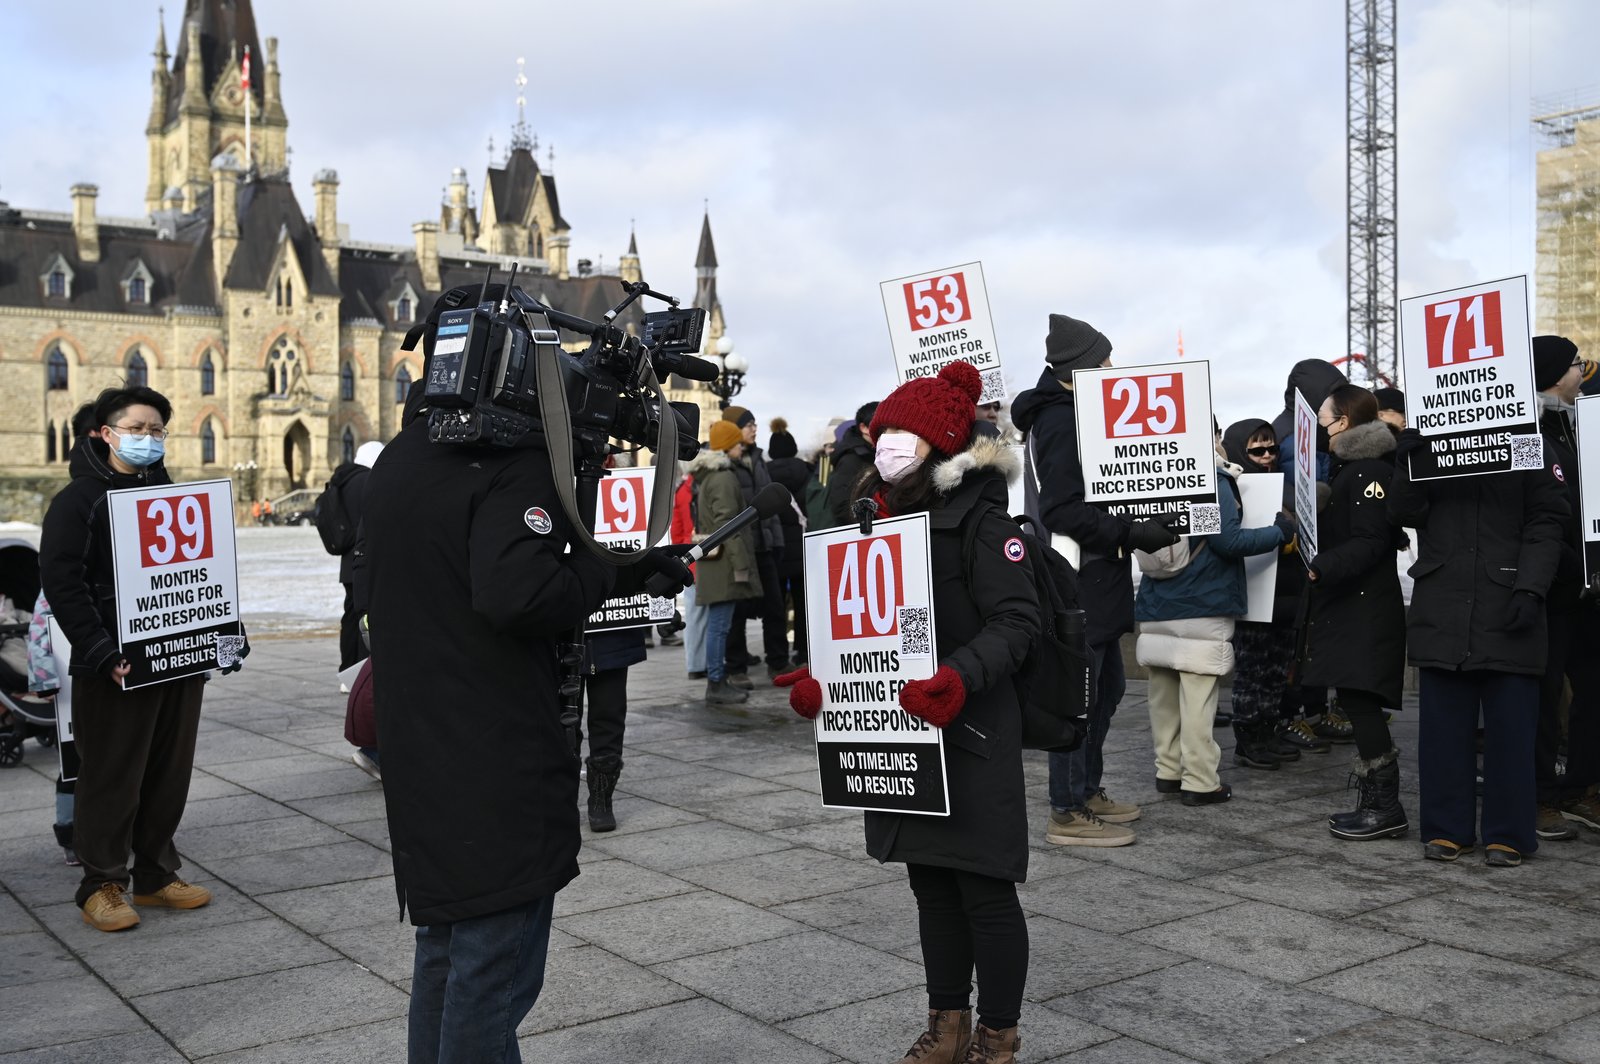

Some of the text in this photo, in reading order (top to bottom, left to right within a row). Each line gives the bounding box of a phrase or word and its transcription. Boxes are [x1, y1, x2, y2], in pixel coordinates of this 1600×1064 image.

[911, 274, 964, 328] 53
[918, 328, 968, 348] MONTHS
[1434, 295, 1494, 365] 71
[908, 339, 984, 365] WAITING FOR
[905, 365, 931, 380] IRCC
[1436, 366, 1497, 389] MONTHS
[1111, 374, 1177, 437] 25
[1422, 383, 1515, 410] WAITING FOR
[1416, 401, 1526, 430] IRCC RESPONSE
[1114, 441, 1179, 459] MONTHS
[1431, 431, 1512, 453] NO TIMELINES
[1099, 457, 1196, 477] WAITING FOR
[1437, 448, 1509, 468] NO RESULTS
[1091, 474, 1207, 495] IRCC RESPONSE
[1108, 500, 1192, 517] NO TIMELINES
[146, 495, 205, 565] 39
[150, 567, 208, 590] MONTHS
[836, 538, 896, 636] 40
[136, 584, 223, 613] WAITING FOR
[129, 601, 232, 634] IRCC RESPONSE
[588, 606, 650, 623] NO RESULTS
[145, 631, 220, 658] NO TIMELINES
[151, 647, 216, 673] NO RESULTS
[840, 650, 900, 675] MONTHS
[827, 680, 887, 703] WAITING
[822, 709, 930, 732] IRCC RESPONSE
[839, 751, 918, 772] NO TIMELINES
[846, 775, 916, 796] NO RESULTS
